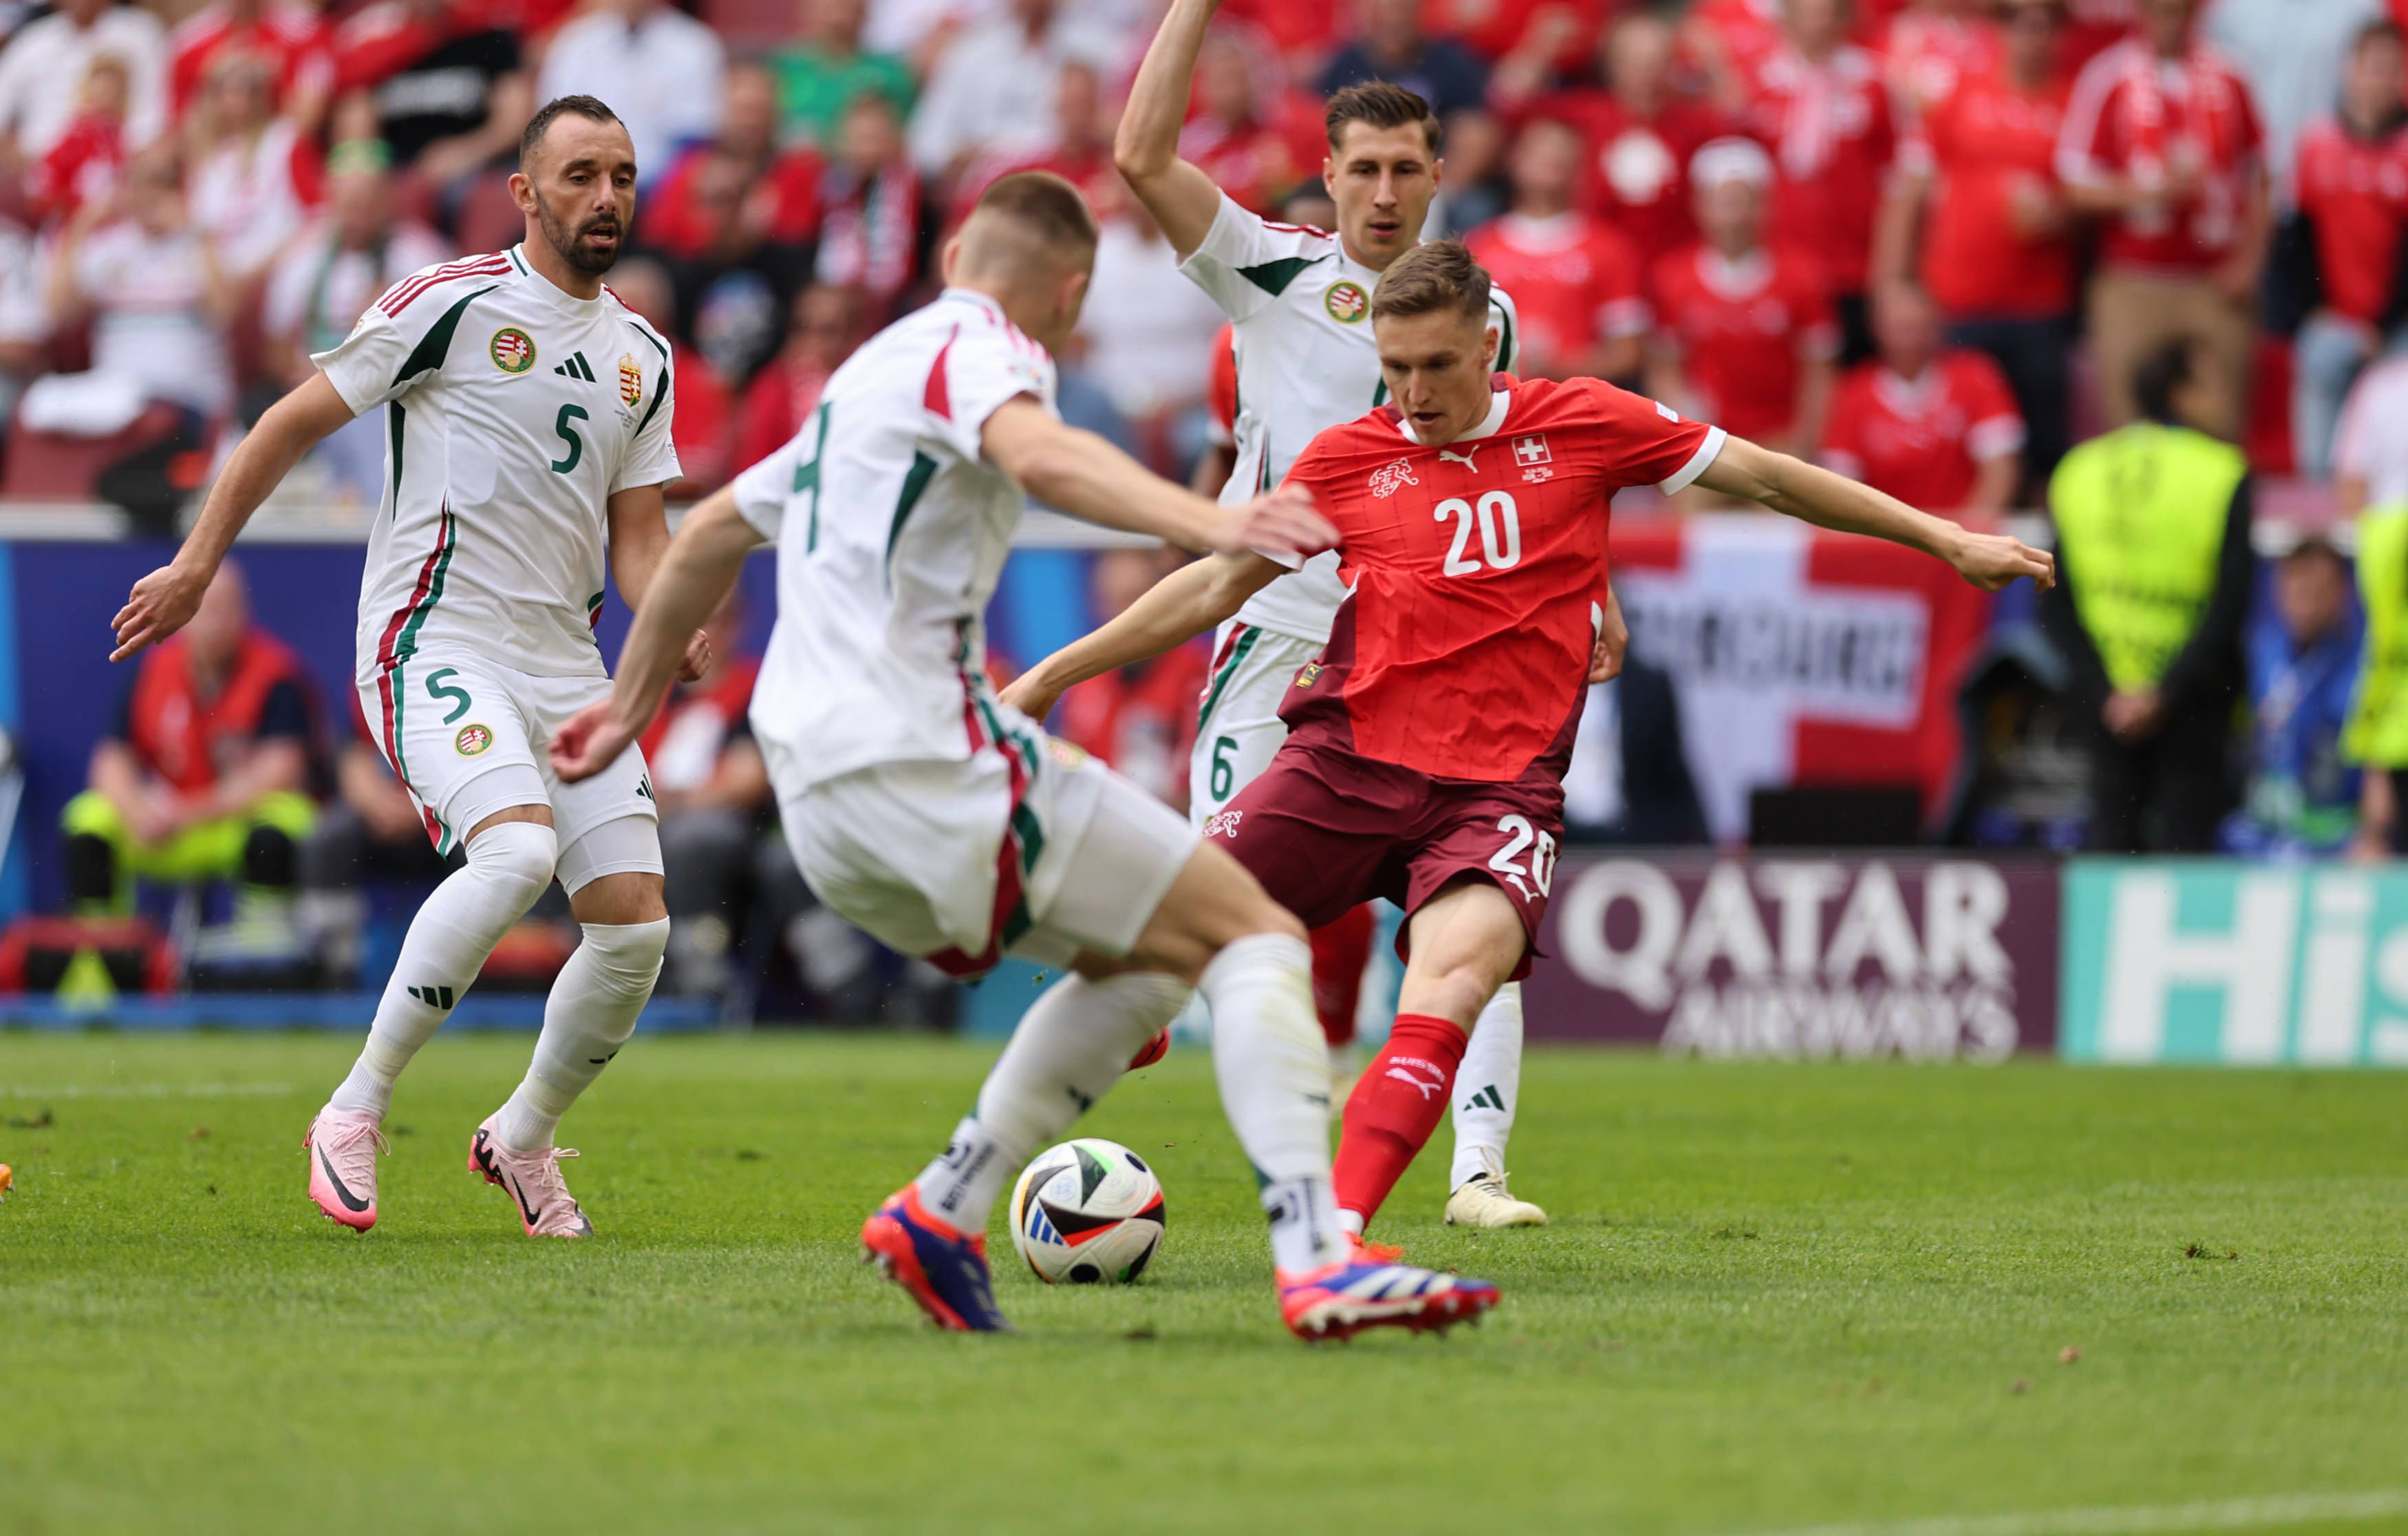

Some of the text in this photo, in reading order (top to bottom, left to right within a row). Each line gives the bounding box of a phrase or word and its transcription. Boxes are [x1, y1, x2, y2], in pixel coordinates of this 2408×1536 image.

[552, 403, 589, 473] 5
[1434, 490, 1521, 577] 20
[424, 668, 472, 725] 5
[1211, 736, 1238, 802] 6
[1488, 814, 1556, 897] 20
[1558, 860, 2016, 1012] QATAR
[1662, 980, 2017, 1061] AIRWAYS
